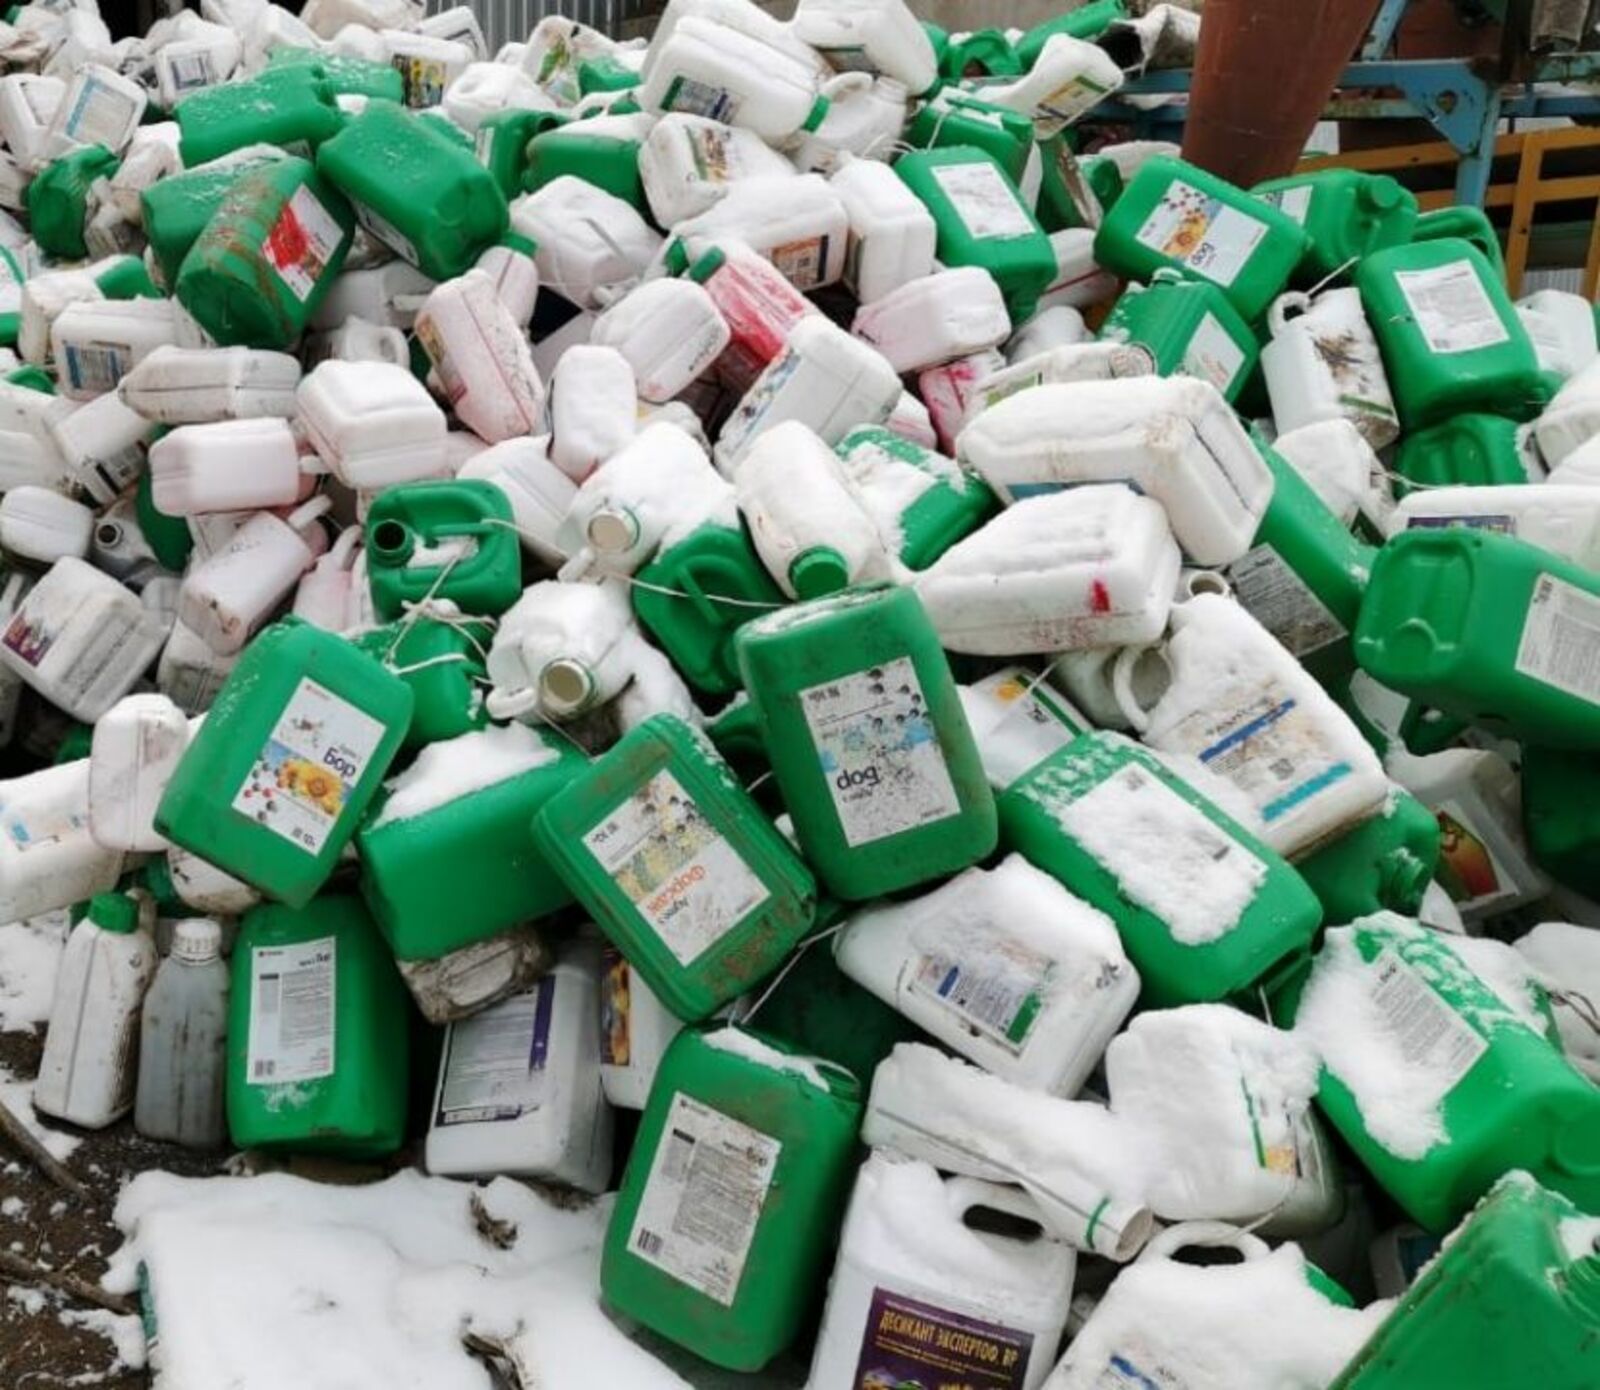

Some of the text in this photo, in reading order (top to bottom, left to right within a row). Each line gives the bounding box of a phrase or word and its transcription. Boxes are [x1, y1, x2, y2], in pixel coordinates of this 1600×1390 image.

[323, 746, 357, 777] Бор
[836, 766, 881, 790] Бор
[879, 1310, 936, 1343] ДЕСИКАНТ
